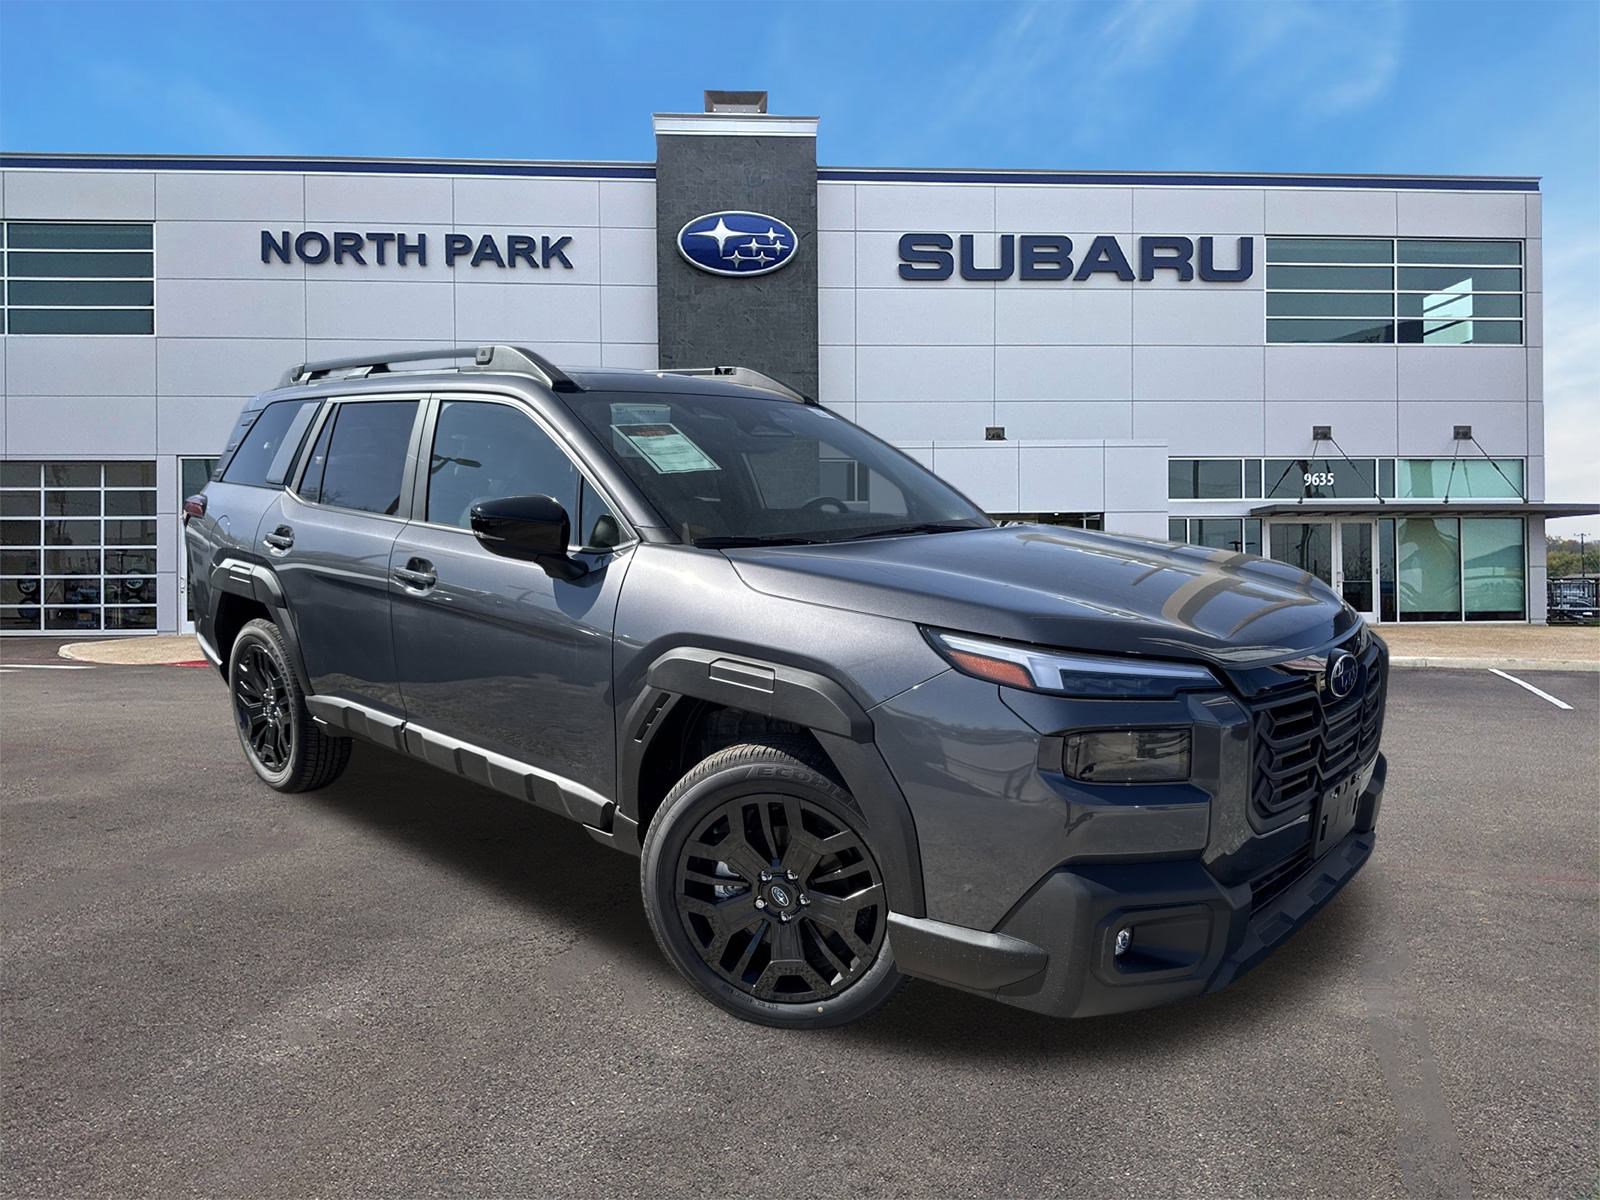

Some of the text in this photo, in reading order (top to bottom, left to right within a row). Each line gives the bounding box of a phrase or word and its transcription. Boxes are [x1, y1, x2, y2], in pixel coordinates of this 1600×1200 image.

[260, 231, 574, 269] NORTH PARK
[898, 233, 1254, 282] SUBARU
[1303, 472, 1335, 486] 9635
